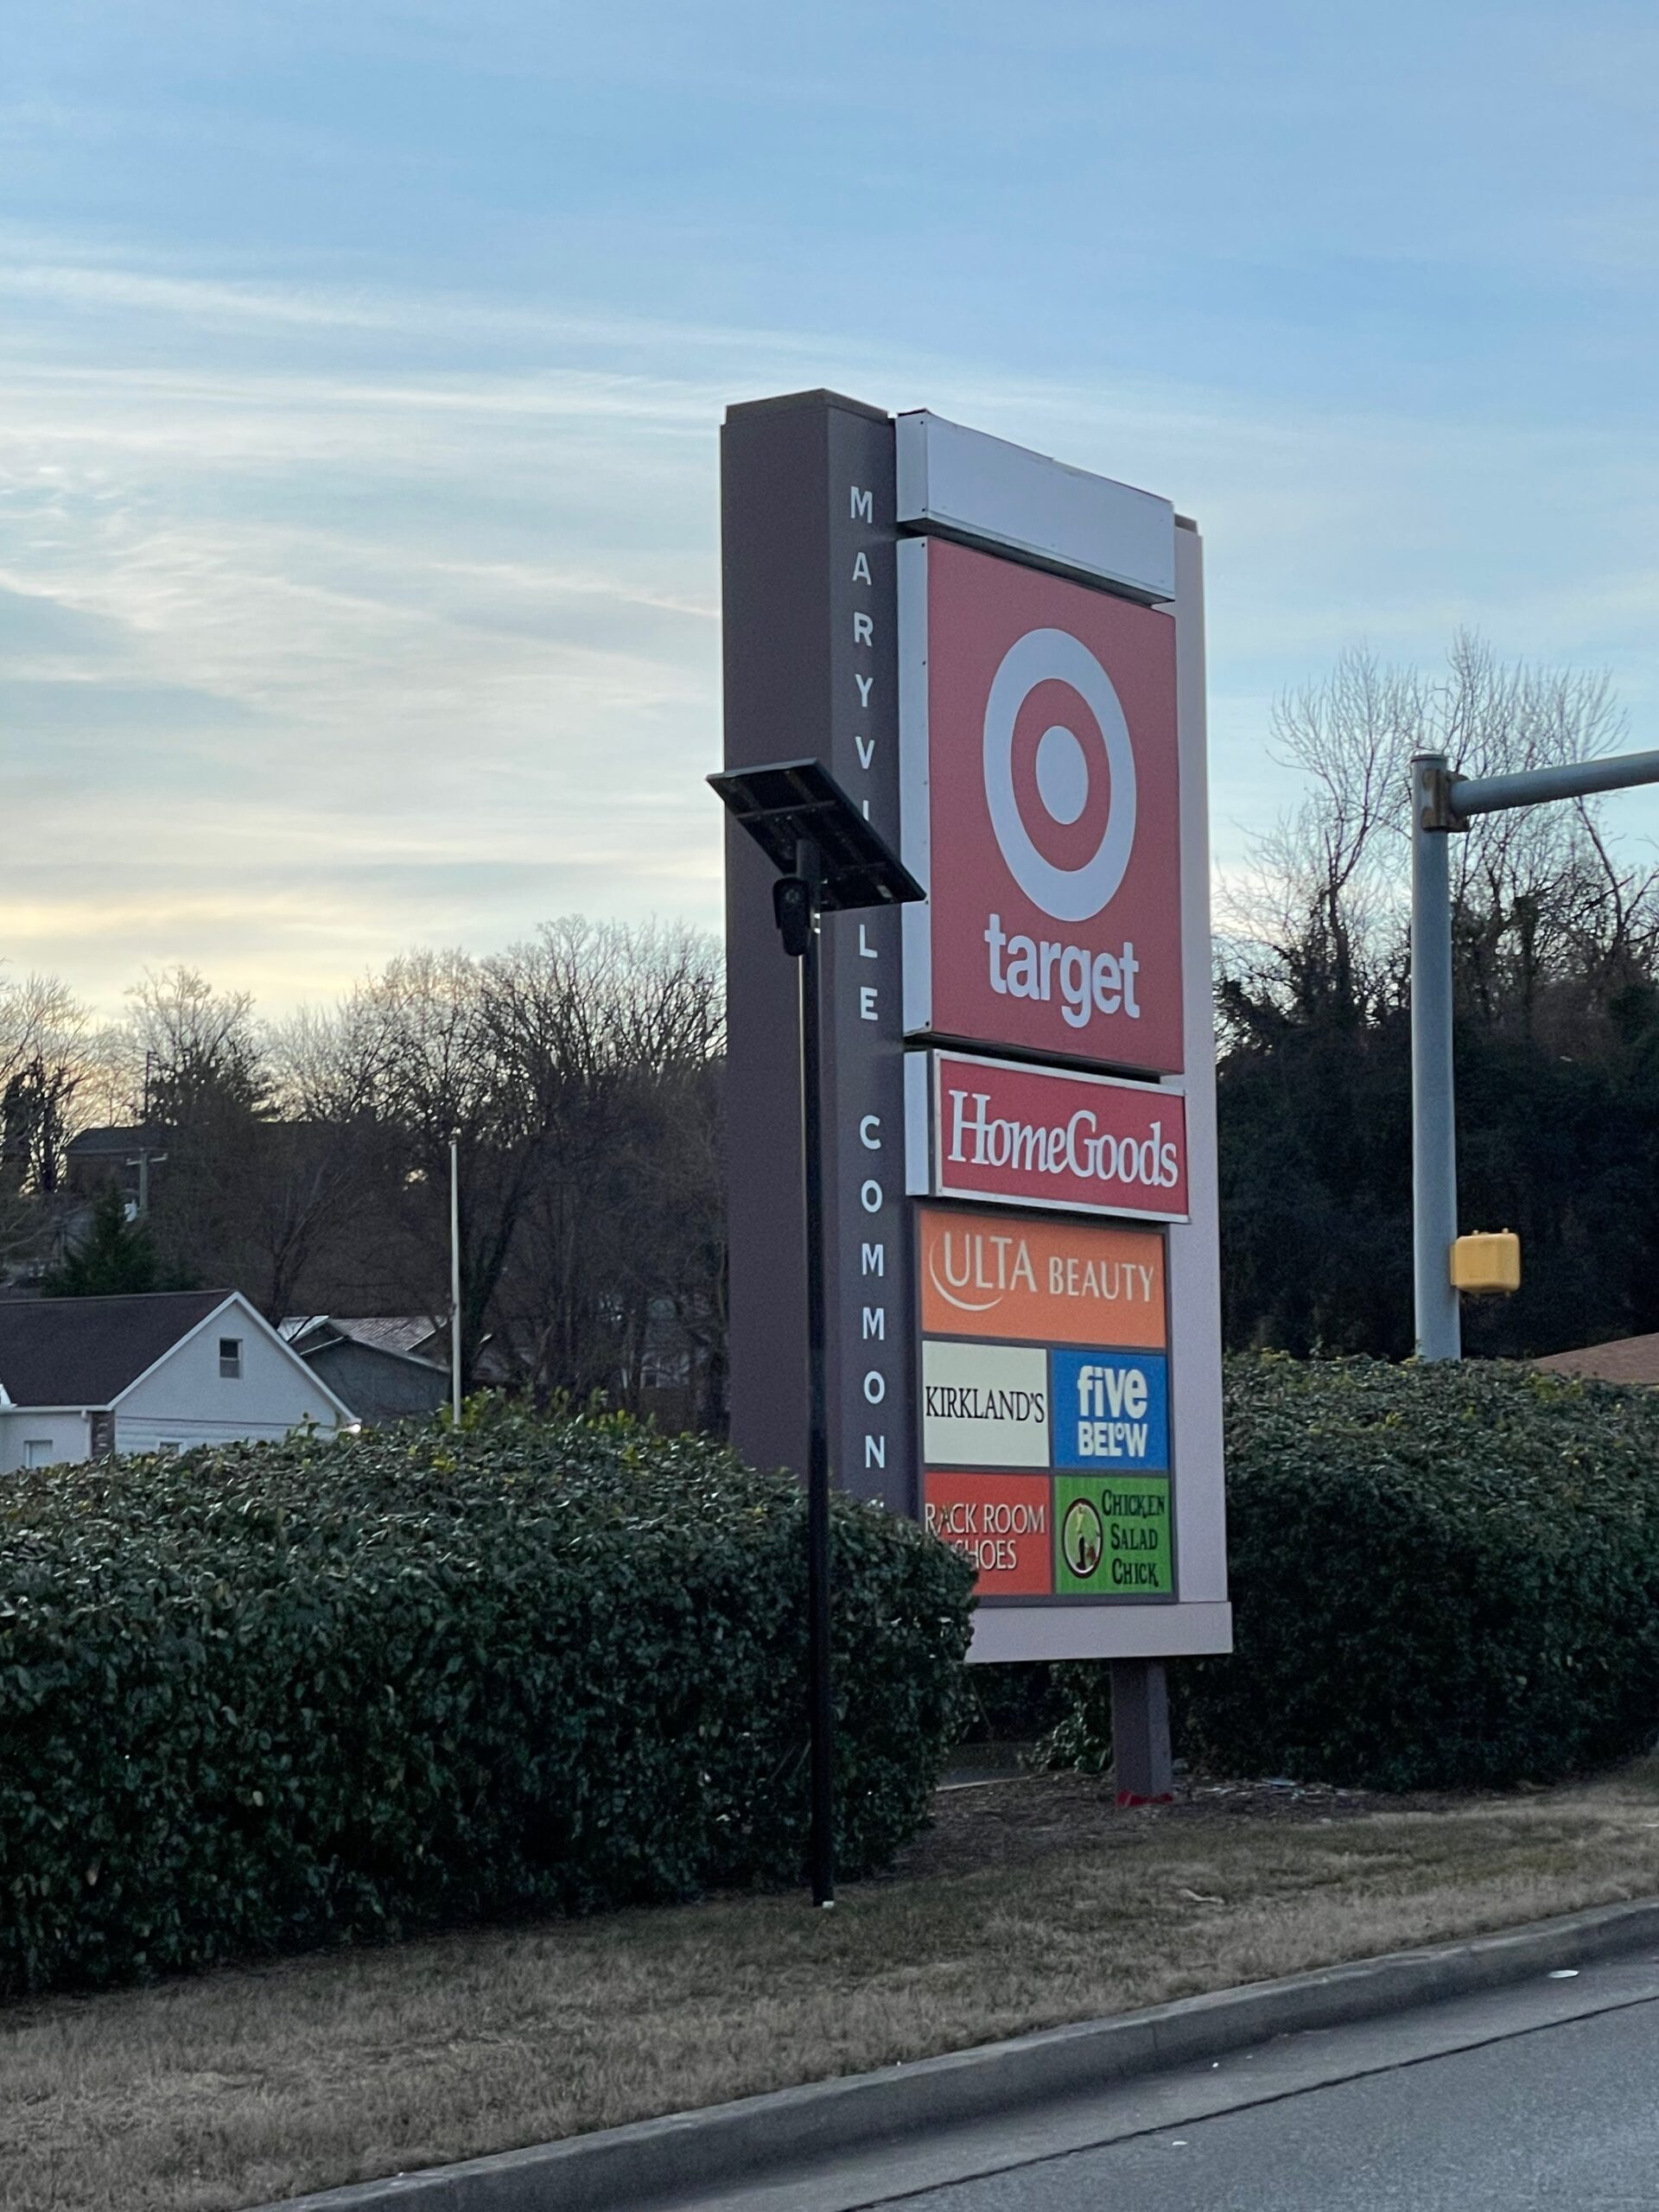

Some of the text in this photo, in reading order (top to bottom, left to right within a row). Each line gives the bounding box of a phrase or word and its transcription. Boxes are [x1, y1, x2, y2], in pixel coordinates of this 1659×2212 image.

[849, 486, 878, 1021] MARYVILE
[984, 912, 1141, 1029] target
[947, 1089, 1179, 1189] HomeGoods
[944, 1231, 1154, 1302] ULTA BEAUTY
[925, 1385, 1046, 1423] KIRKLAND'S
[1077, 1364, 1149, 1420] five
[1077, 1420, 1148, 1458] BELOW
[982, 1503, 1045, 1535] ROOM
